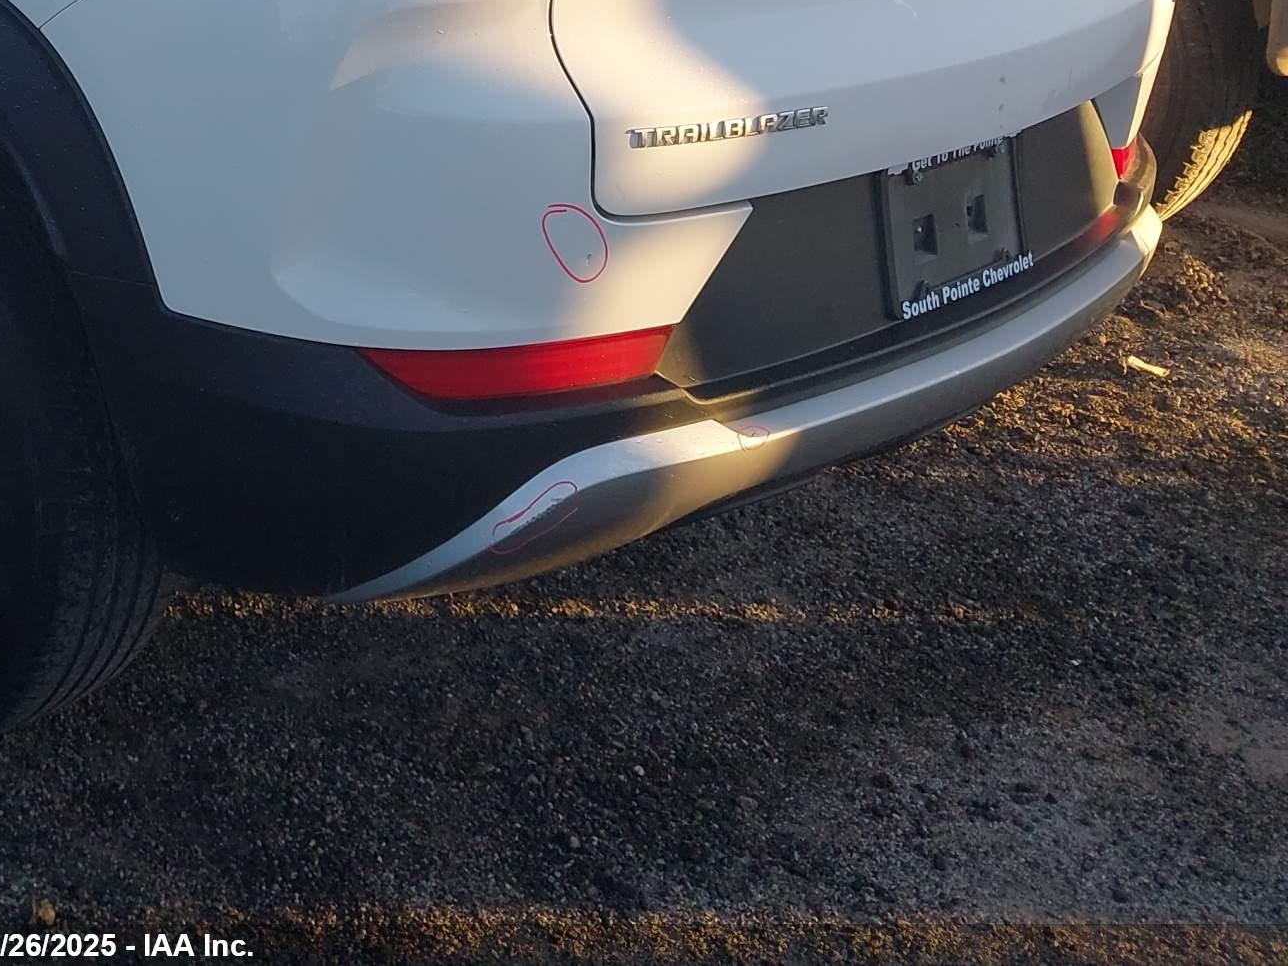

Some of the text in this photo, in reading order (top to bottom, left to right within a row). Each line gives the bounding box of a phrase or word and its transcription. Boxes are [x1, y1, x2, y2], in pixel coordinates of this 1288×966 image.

[626, 106, 829, 149] TRAILBLAZER
[912, 158, 932, 171] Get
[902, 251, 1034, 320] South Pointe Chevrolet
